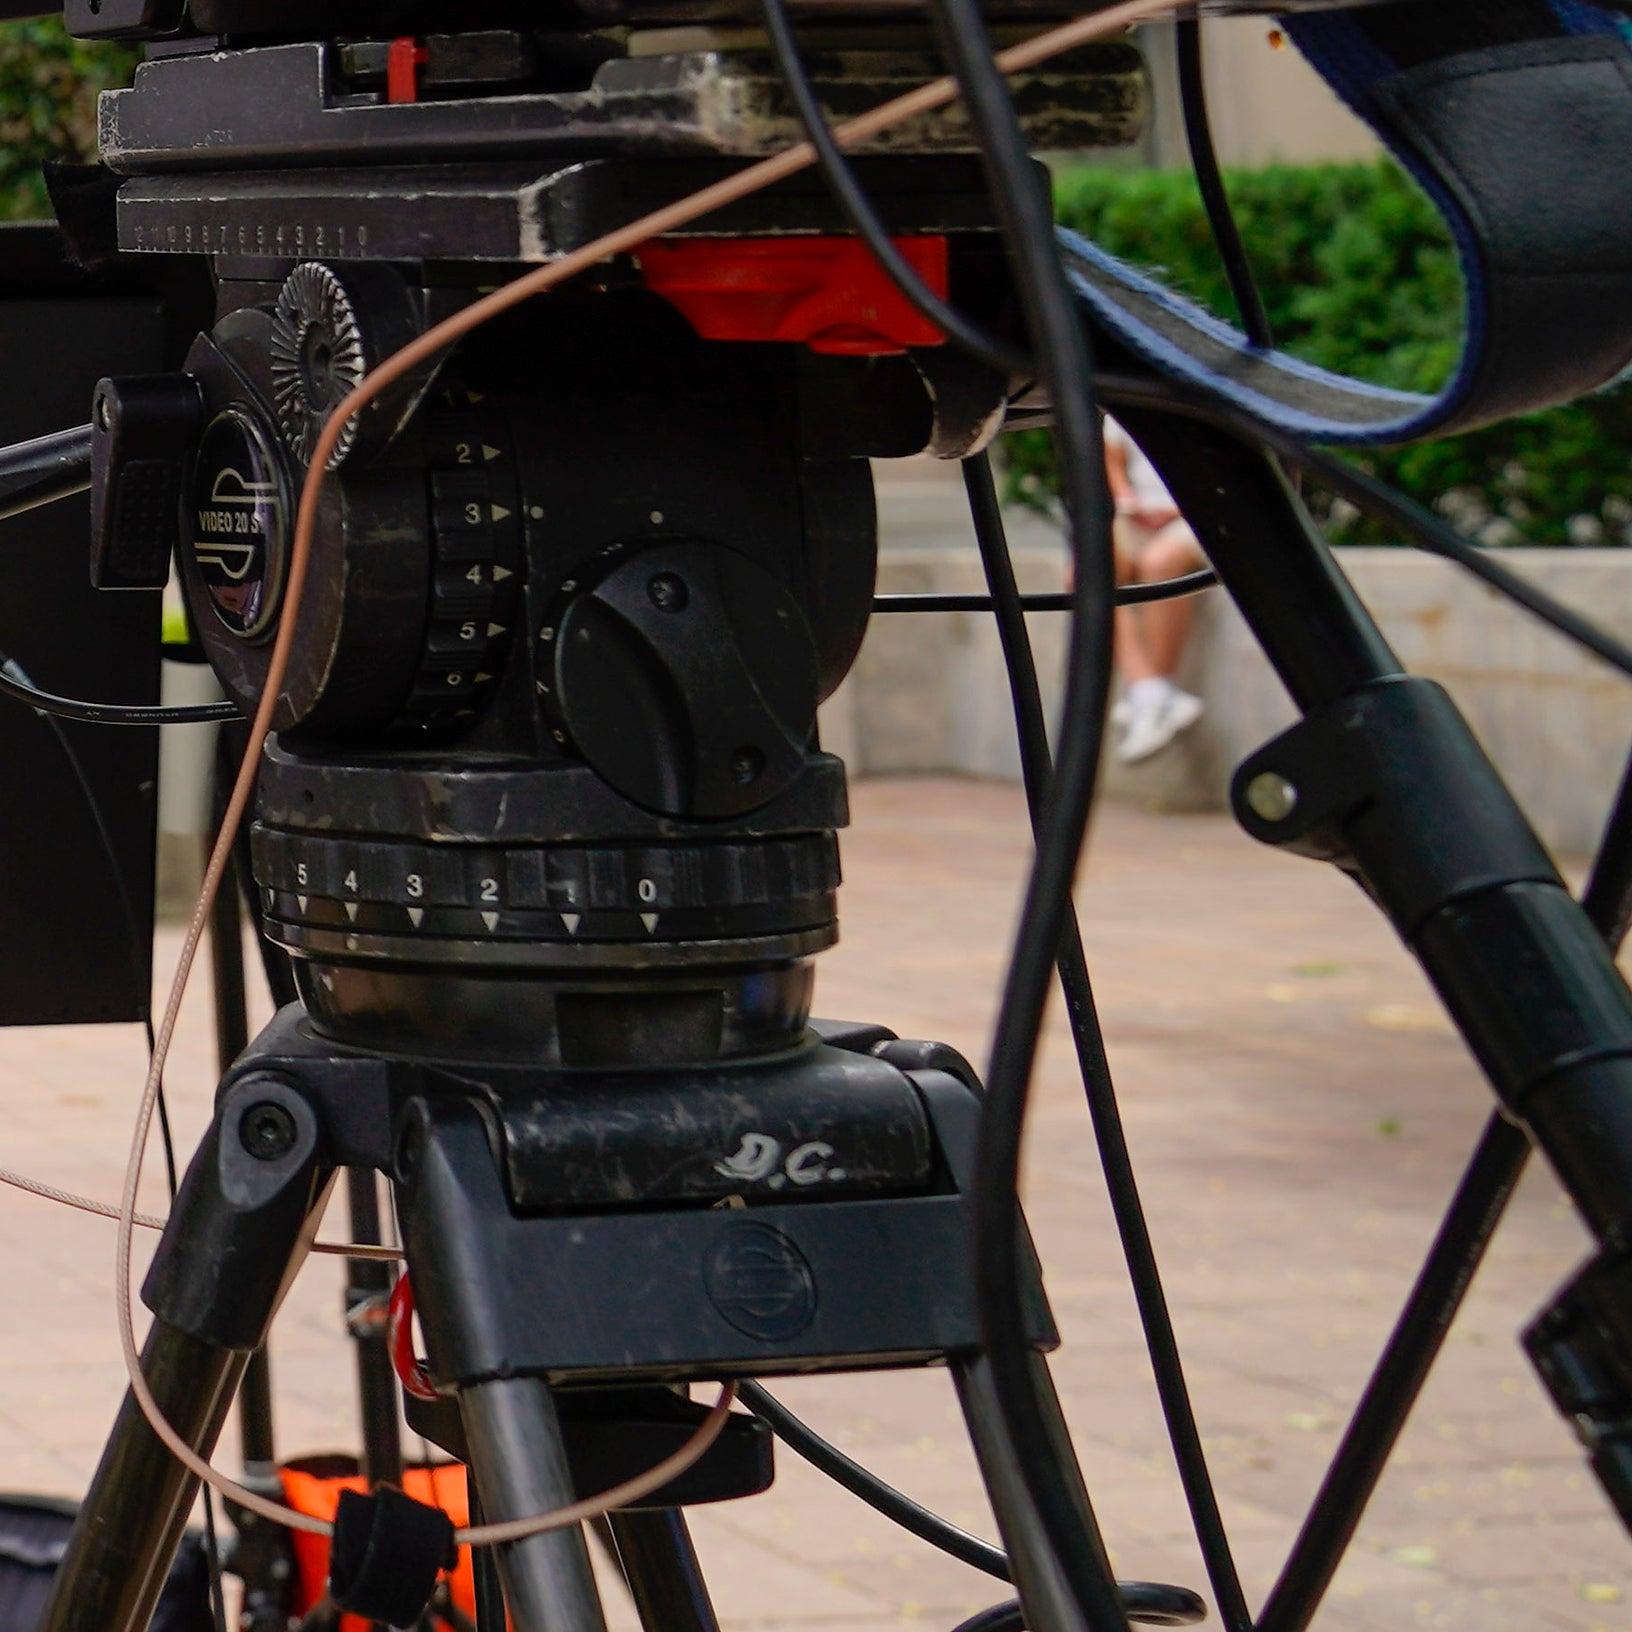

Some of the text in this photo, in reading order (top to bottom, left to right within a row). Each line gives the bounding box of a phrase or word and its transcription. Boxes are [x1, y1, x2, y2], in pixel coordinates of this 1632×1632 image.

[455, 443, 472, 464] 2
[198, 510, 233, 533] VIDEO
[235, 511, 249, 534] 20
[464, 502, 481, 525] 3
[465, 564, 483, 585] 4
[459, 622, 476, 641] 5
[297, 862, 308, 885] 5
[344, 869, 359, 893] 4
[405, 873, 424, 898] 3
[479, 877, 499, 903] 2
[638, 878, 657, 903] 0
